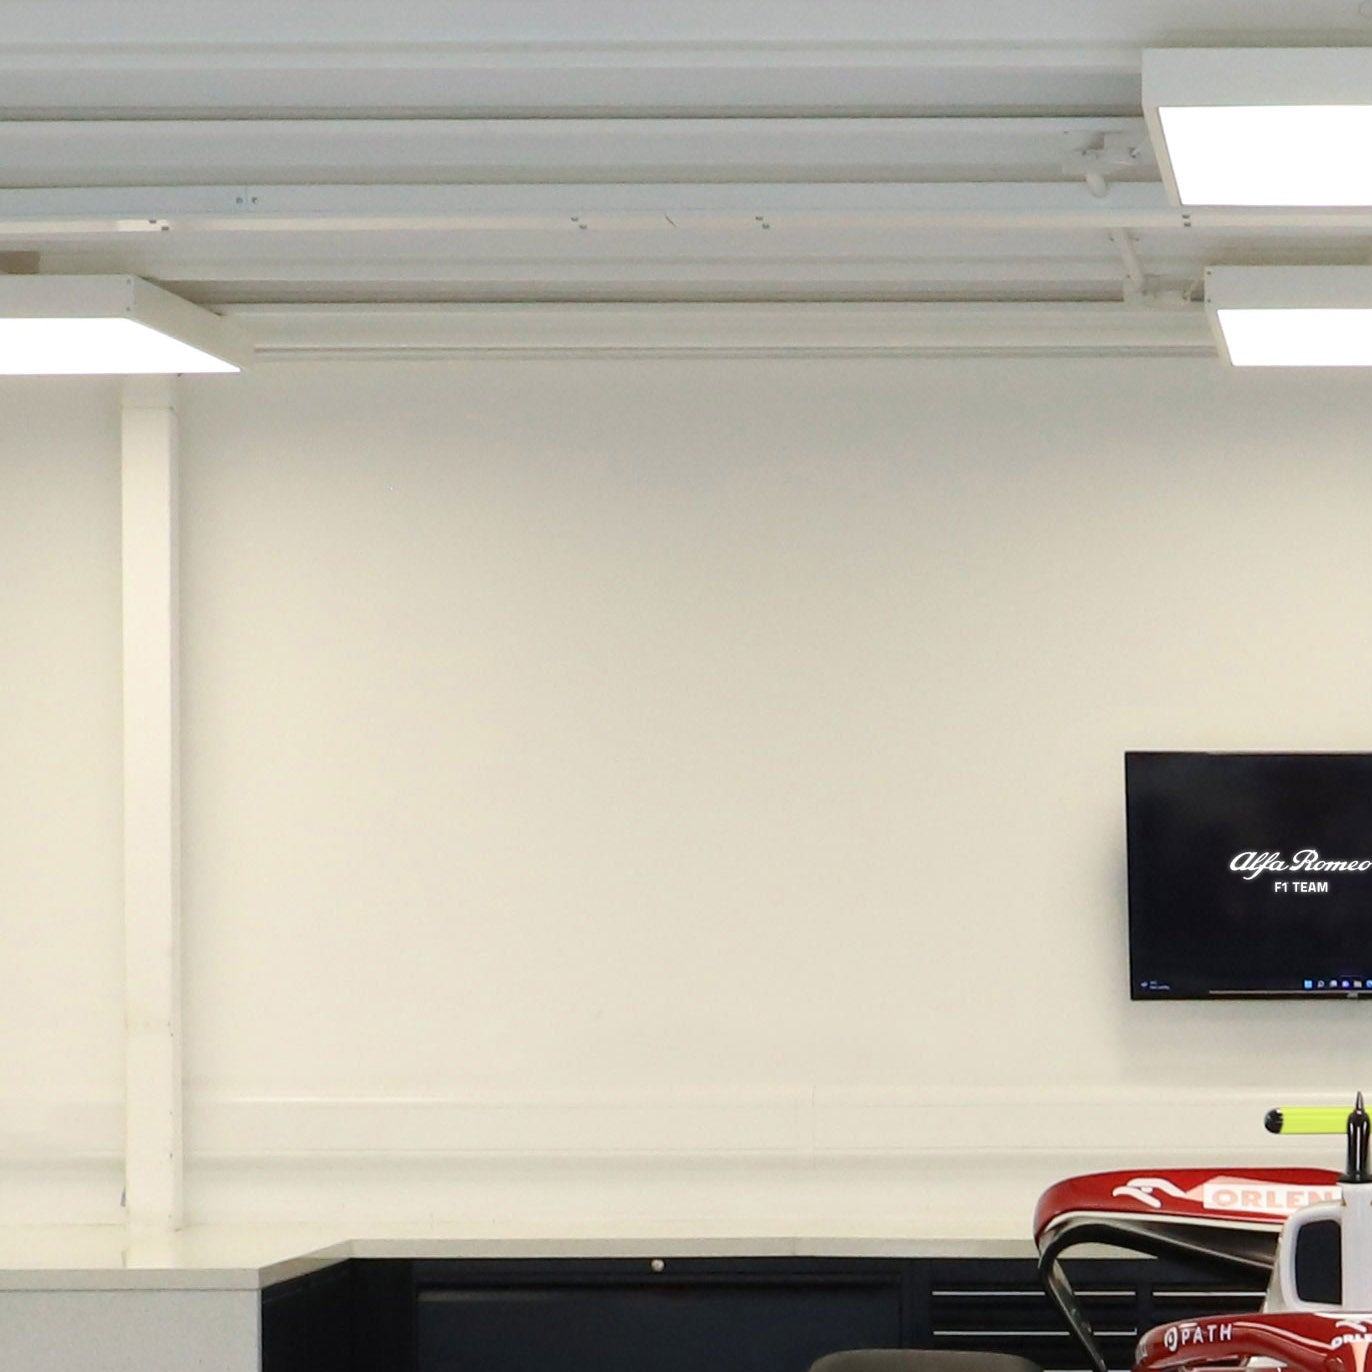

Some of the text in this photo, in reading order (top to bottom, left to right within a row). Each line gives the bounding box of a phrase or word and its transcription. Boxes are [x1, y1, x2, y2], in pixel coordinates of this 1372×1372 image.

[1229, 849, 1289, 881] Alfa
[1274, 881, 1329, 893] F1 TEAM
[1211, 1188, 1334, 1209] ORLEN
[1181, 1323, 1234, 1346] PATH
